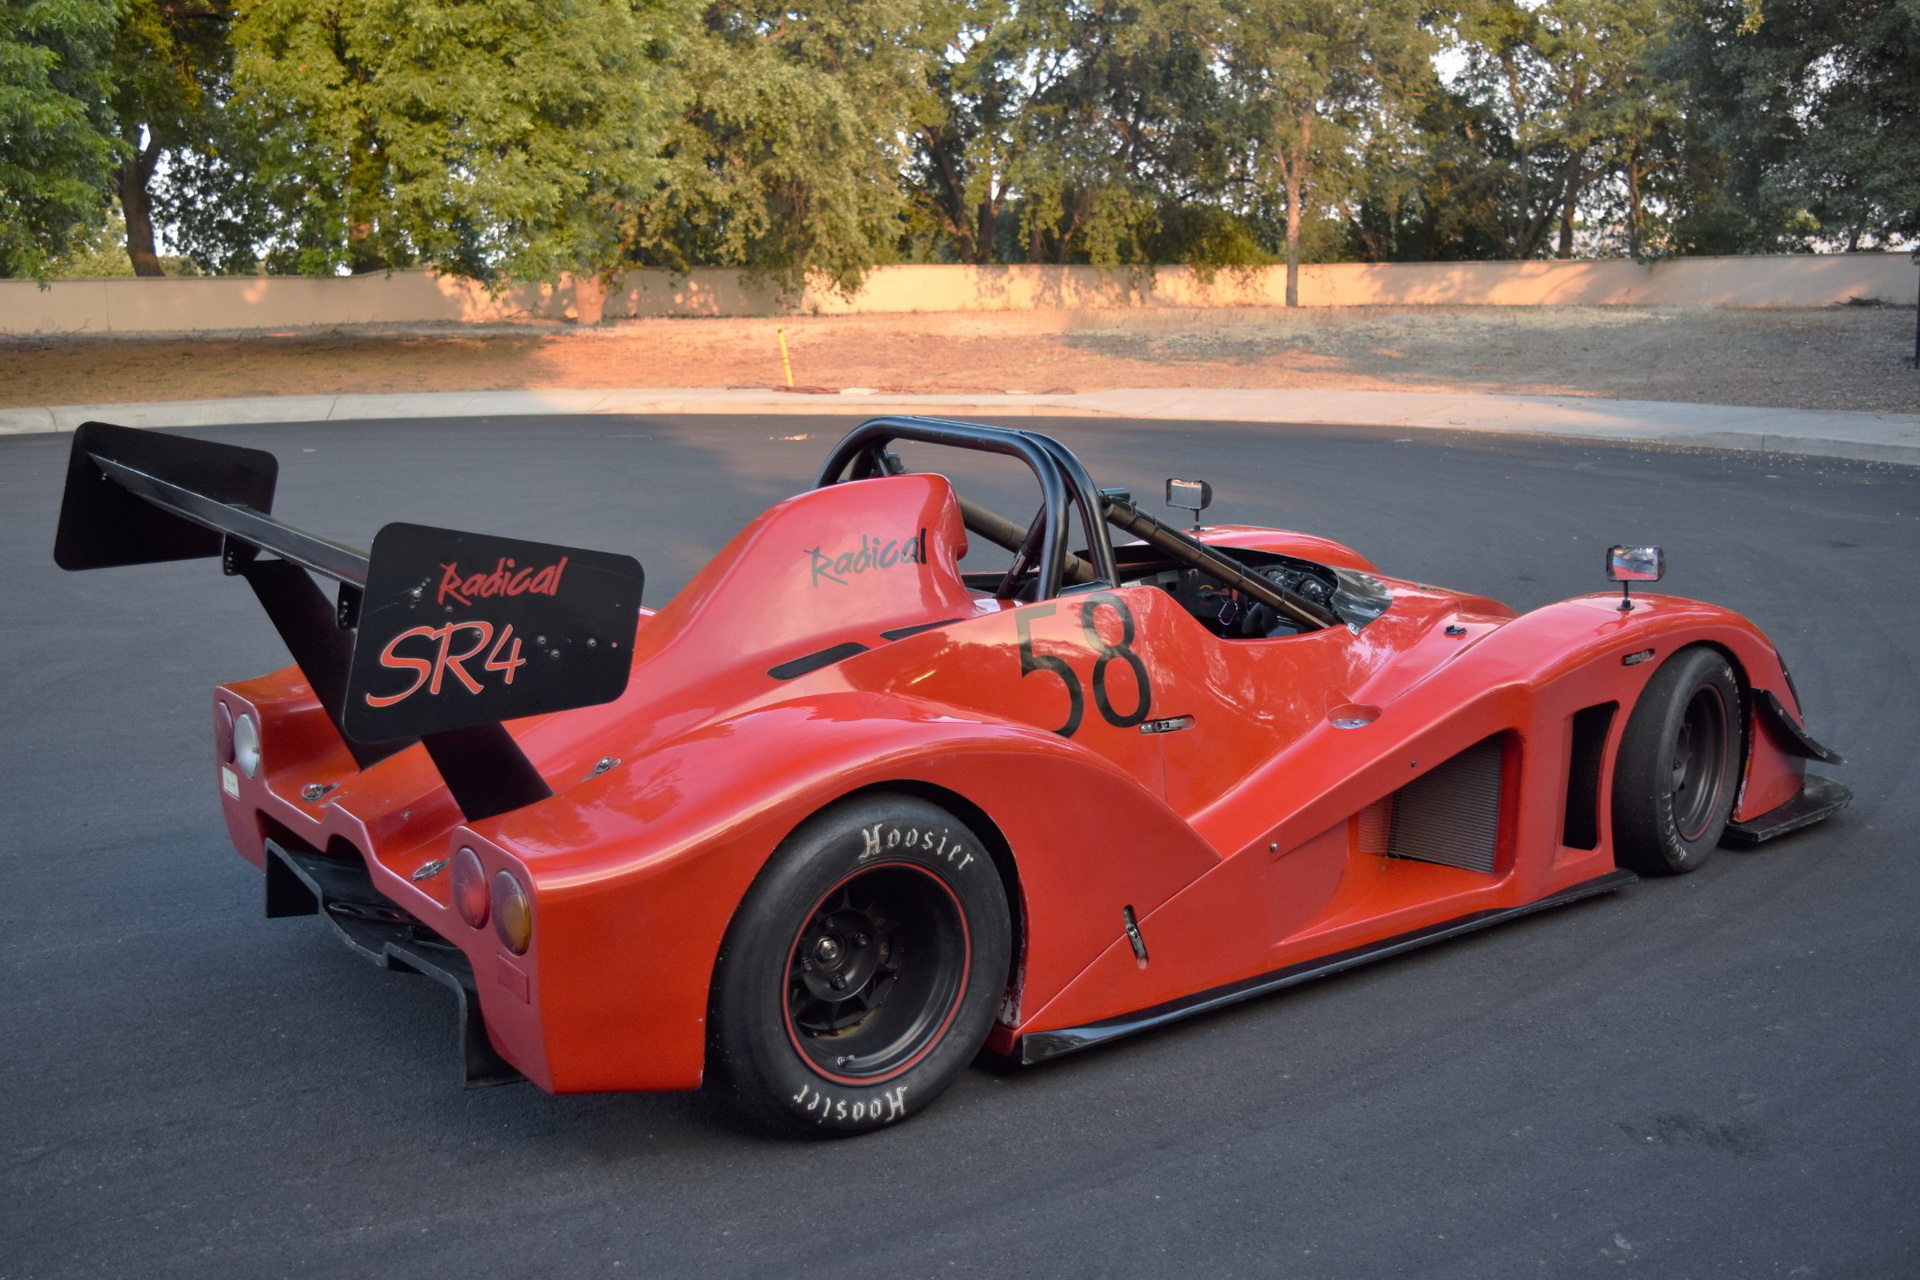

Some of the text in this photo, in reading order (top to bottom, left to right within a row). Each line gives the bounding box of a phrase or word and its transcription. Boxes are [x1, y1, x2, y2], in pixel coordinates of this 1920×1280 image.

[437, 556, 568, 606] Radical
[803, 528, 927, 588] Radical
[366, 621, 527, 708] SR4
[1015, 593, 1151, 738] 58
[858, 823, 974, 870] Hoosier
[793, 1084, 908, 1124] Hoosier
